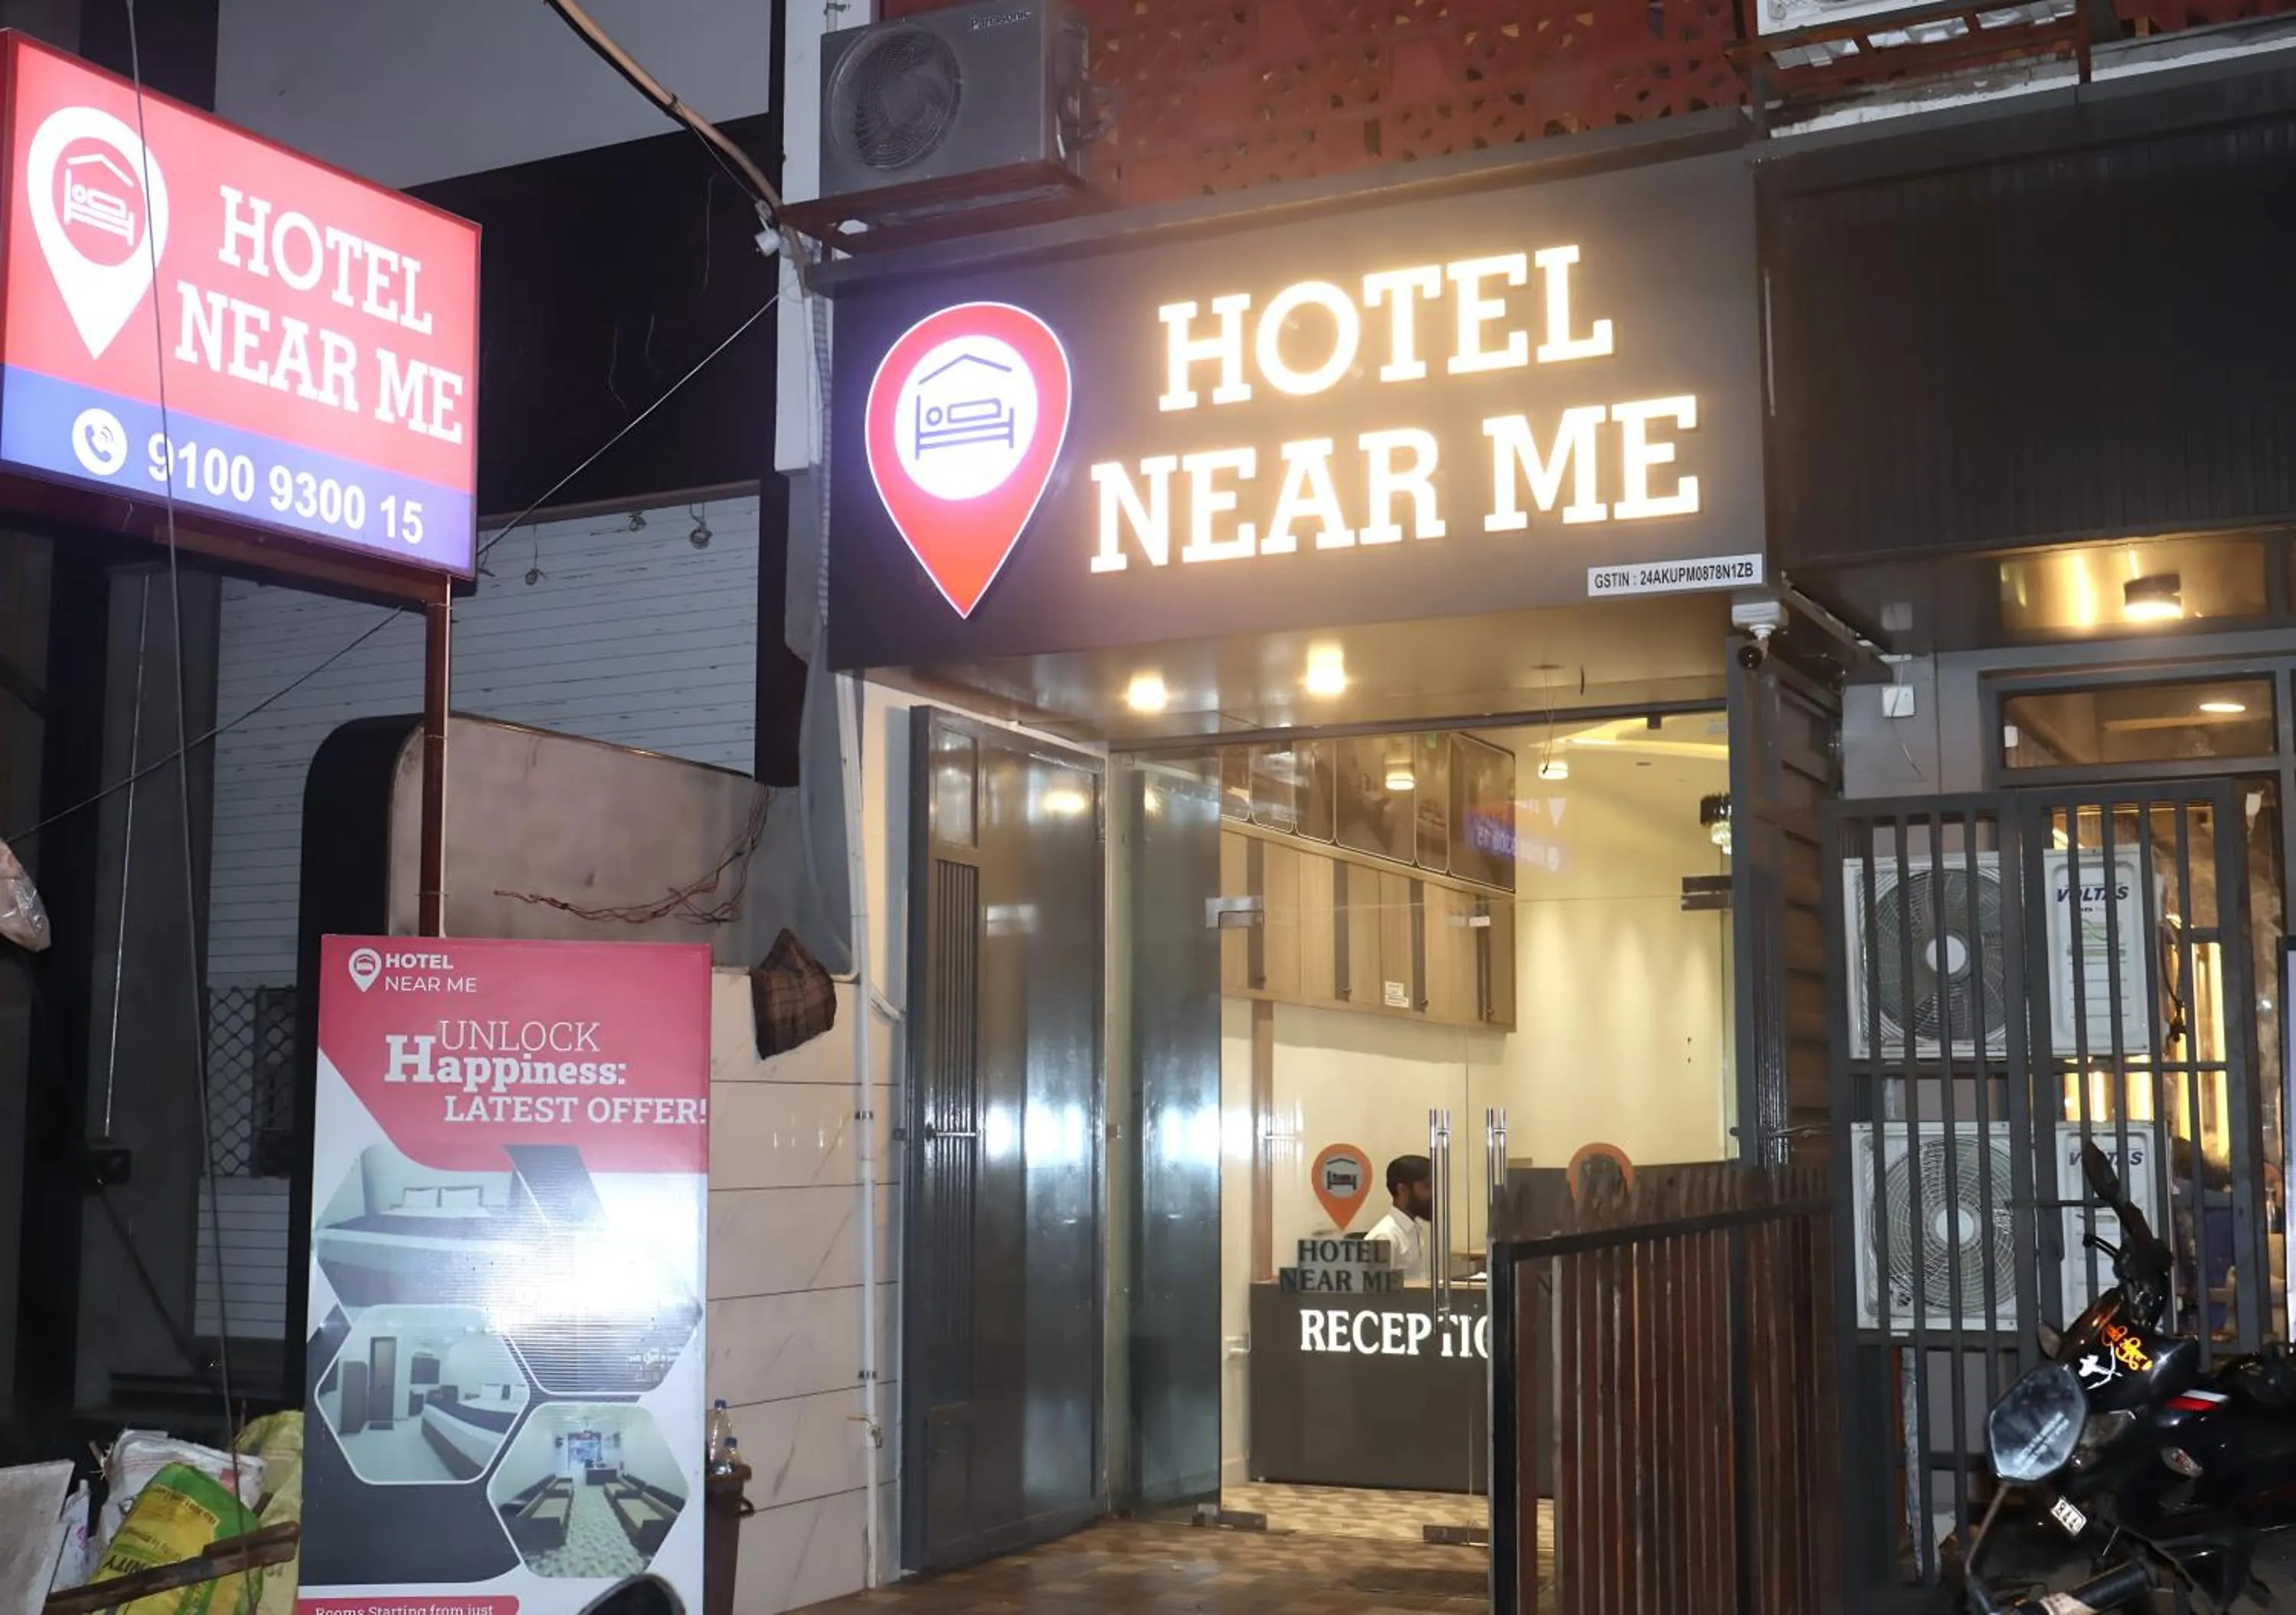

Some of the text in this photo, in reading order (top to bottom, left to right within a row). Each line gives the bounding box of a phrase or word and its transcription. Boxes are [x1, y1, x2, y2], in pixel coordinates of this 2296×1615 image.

[218, 184, 432, 335] HOTEL
[1156, 243, 1614, 412] HOTEL
[175, 280, 463, 444] NEAR ME
[148, 432, 424, 545] 9100 9300 15
[1089, 394, 1701, 574] NEAR ME
[1594, 572, 1630, 589] GSTIN
[2056, 886, 2129, 902] VLTS
[385, 953, 454, 970] HOTEL
[385, 975, 478, 993] NEAR ME
[439, 1020, 601, 1052] UNLOCK
[384, 1034, 628, 1093] Happiness:
[444, 1095, 707, 1125] LATEST OFFER!
[1298, 1241, 1389, 1263] HOTEL
[1280, 1268, 1404, 1292] NEAR ME
